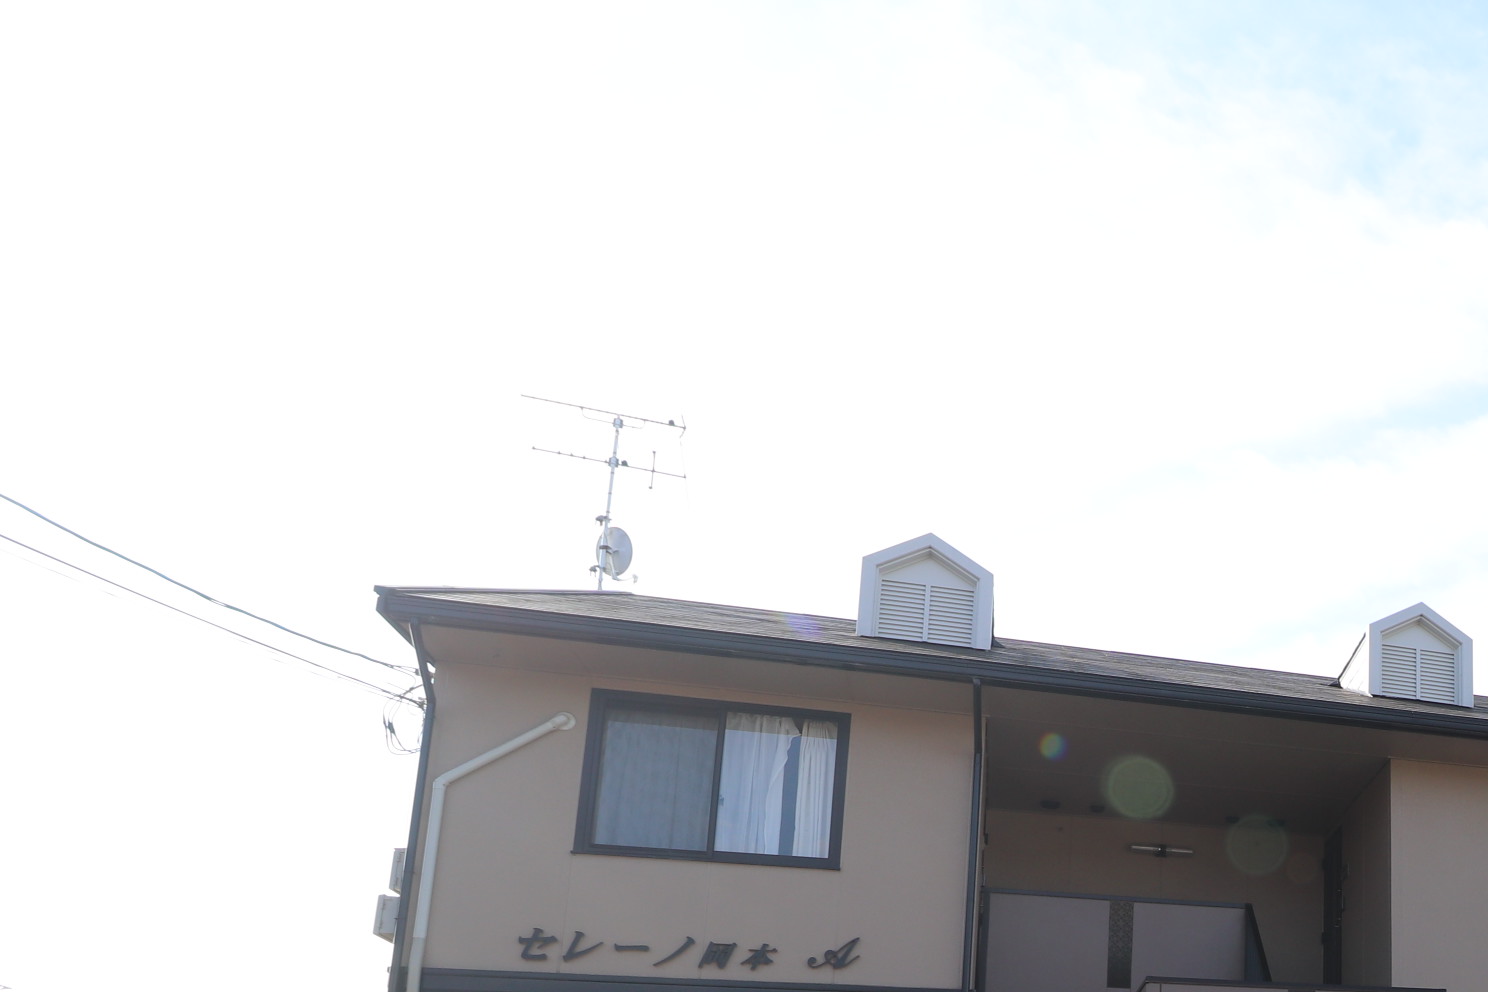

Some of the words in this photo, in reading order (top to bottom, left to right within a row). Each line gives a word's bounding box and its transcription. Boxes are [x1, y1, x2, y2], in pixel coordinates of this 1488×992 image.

[518, 927, 779, 971] セレーノ岡本
[807, 936, 861, 970] A
